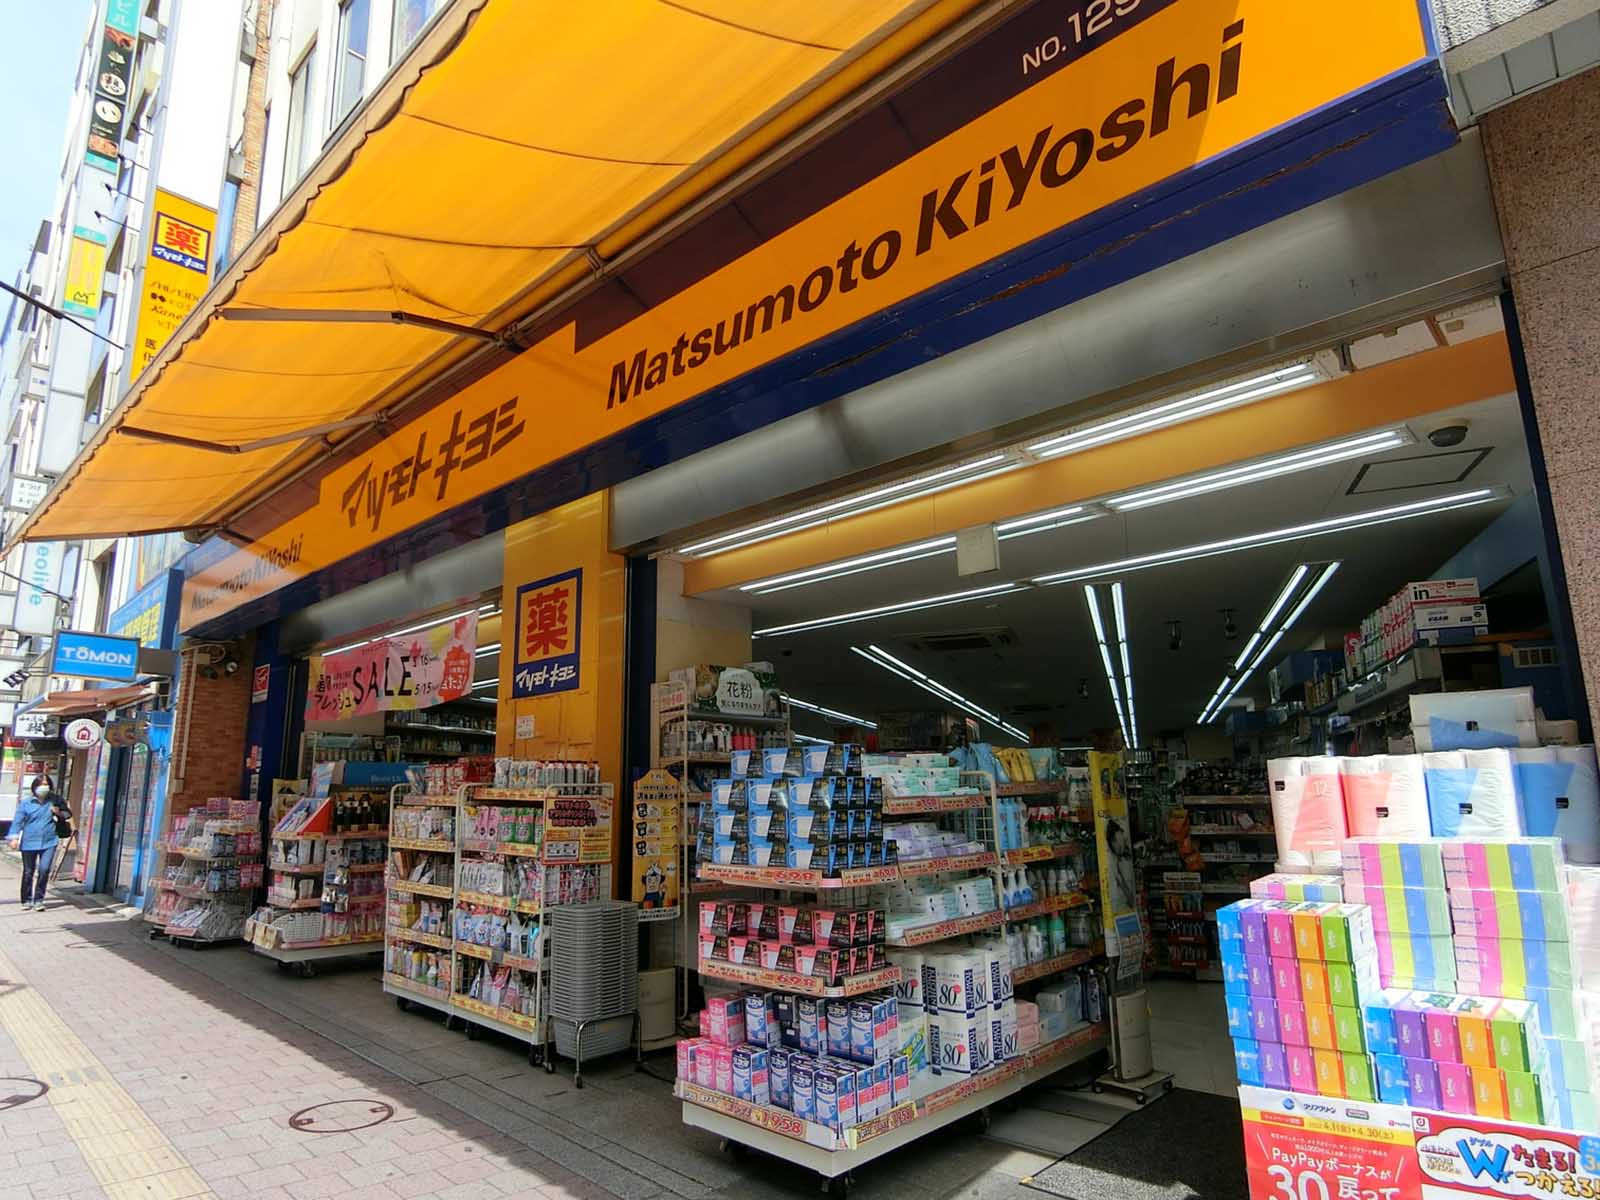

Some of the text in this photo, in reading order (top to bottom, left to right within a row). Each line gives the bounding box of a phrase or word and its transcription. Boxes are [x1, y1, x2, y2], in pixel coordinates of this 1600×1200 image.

[1022, 36, 1067, 74] NO.
[607, 18, 1244, 410] Matsumoto KiYoshi
[527, 587, 569, 657] 薬
[353, 655, 412, 705] SALE
[727, 681, 753, 700] 花粉
[940, 984, 959, 1006] 80
[942, 1044, 962, 1066] 80
[764, 1110, 804, 1134] 1958
[1271, 1147, 1393, 1181] PayPayボーナスが
[1455, 1138, 1510, 1183] W
[1511, 1143, 1577, 1175] たまる!
[1266, 1164, 1331, 1200] 30
